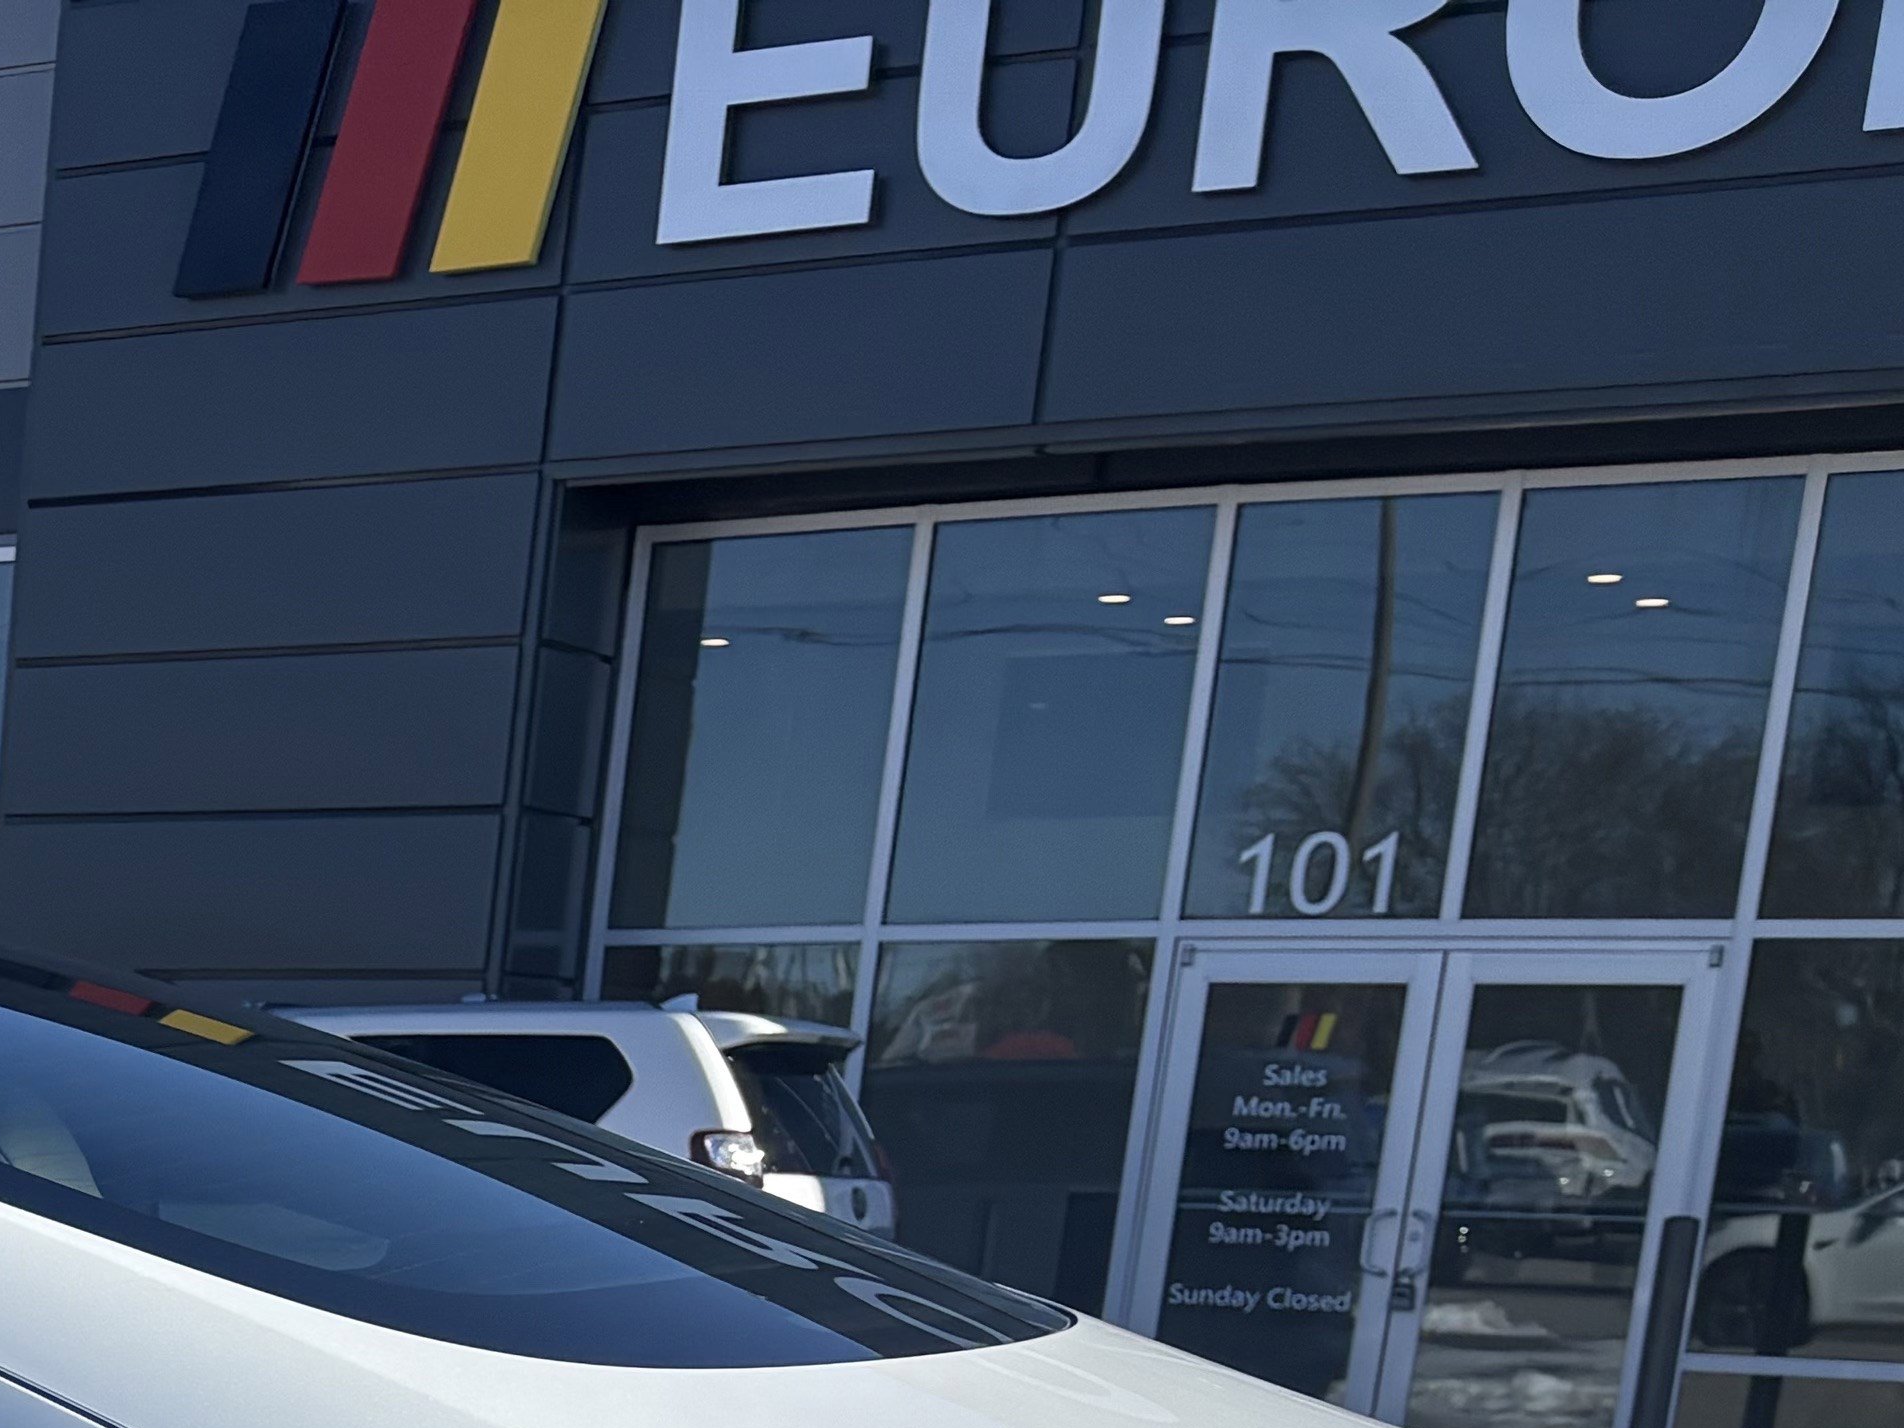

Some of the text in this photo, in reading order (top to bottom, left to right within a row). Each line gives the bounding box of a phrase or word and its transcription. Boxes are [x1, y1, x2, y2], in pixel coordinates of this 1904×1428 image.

[655, 0, 1904, 244] EURO
[1239, 830, 1400, 915] 101
[1262, 1063, 1327, 1087] Sales
[1223, 1127, 1346, 1156] 9am-6pm
[1216, 1190, 1331, 1221] Saturday
[1208, 1221, 1331, 1251] 9am-3pm
[1168, 1282, 1353, 1313] Sunday Closed
